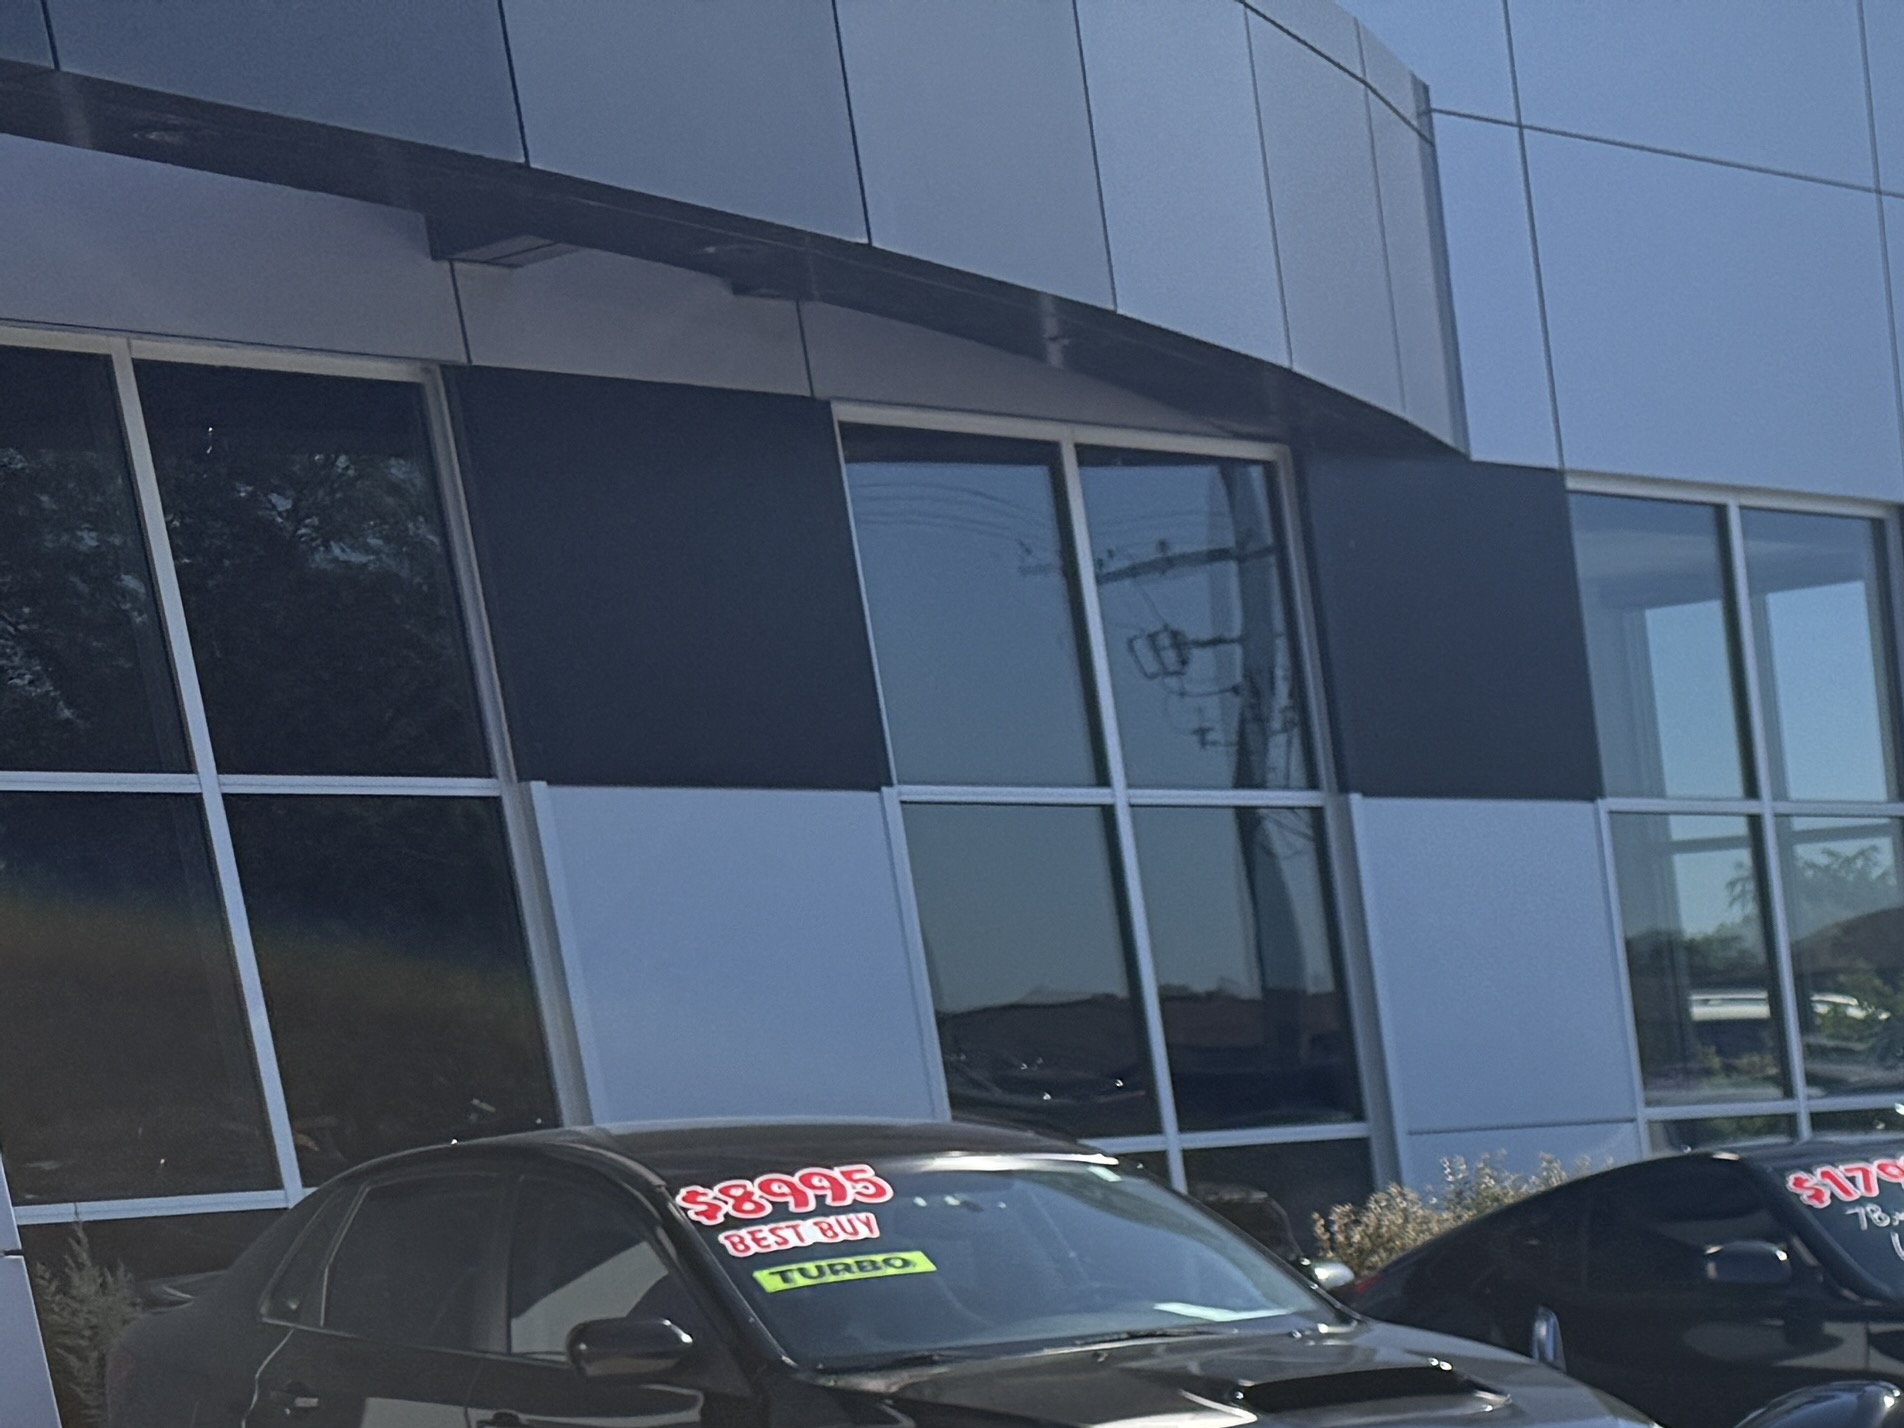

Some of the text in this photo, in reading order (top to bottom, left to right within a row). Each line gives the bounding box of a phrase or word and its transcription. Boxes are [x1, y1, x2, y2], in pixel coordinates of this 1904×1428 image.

[677, 1164, 894, 1226] $8995
[724, 1214, 878, 1254] BEST BUY
[771, 1257, 913, 1284] TURBO
